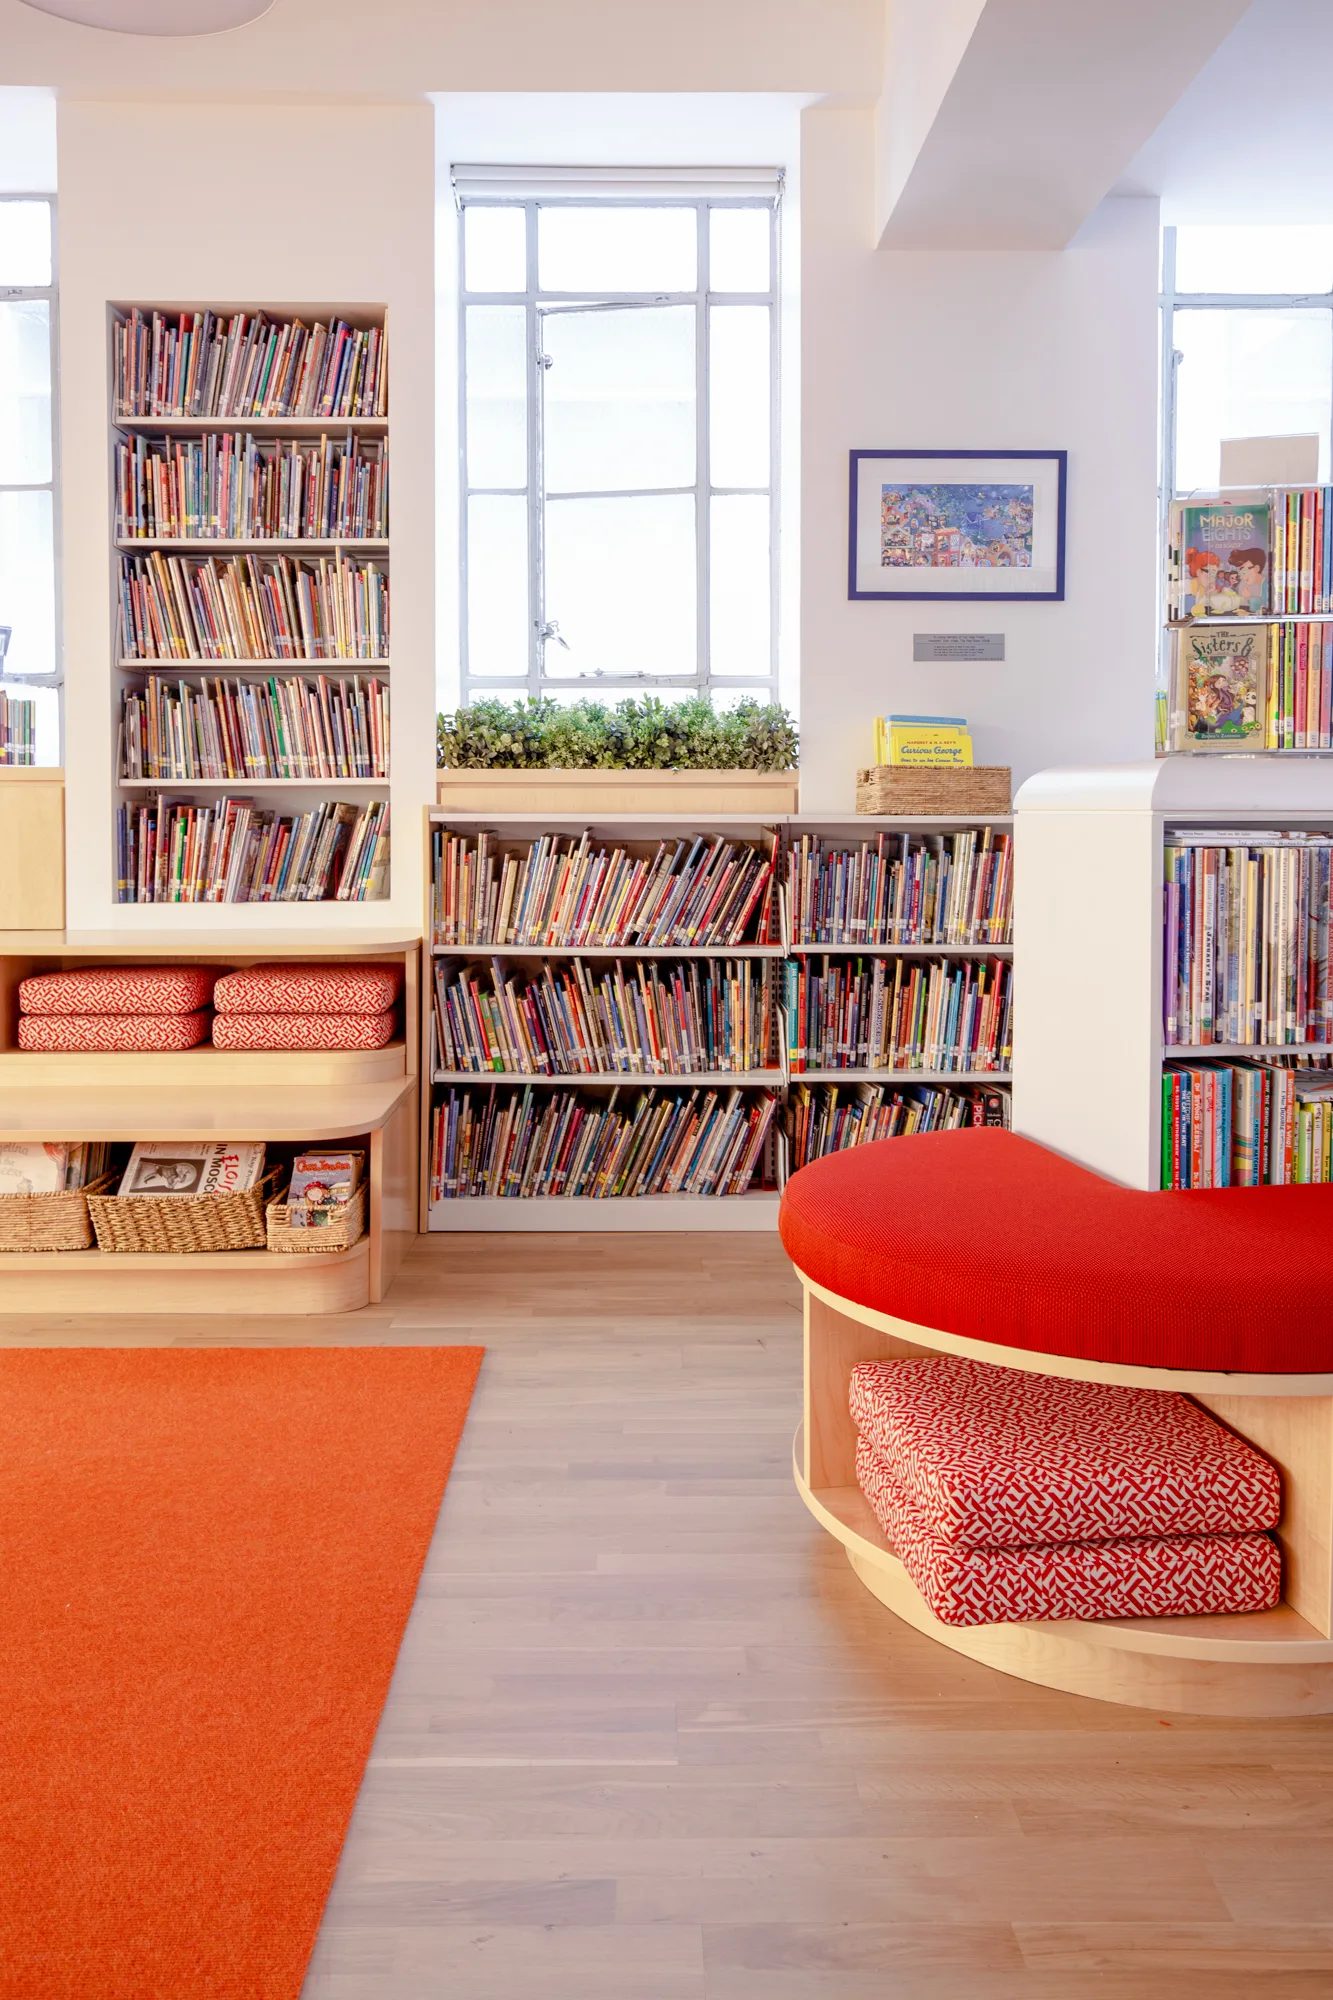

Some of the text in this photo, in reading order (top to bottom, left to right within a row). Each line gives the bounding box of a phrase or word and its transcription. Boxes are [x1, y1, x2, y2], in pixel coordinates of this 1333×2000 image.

[1200, 512, 1254, 528] MAJOR
[1192, 638, 1240, 660] Sisters
[901, 746, 962, 756] Curious George
[214, 1144, 228, 1155] IN
[214, 1154, 239, 1193] ELOIS
